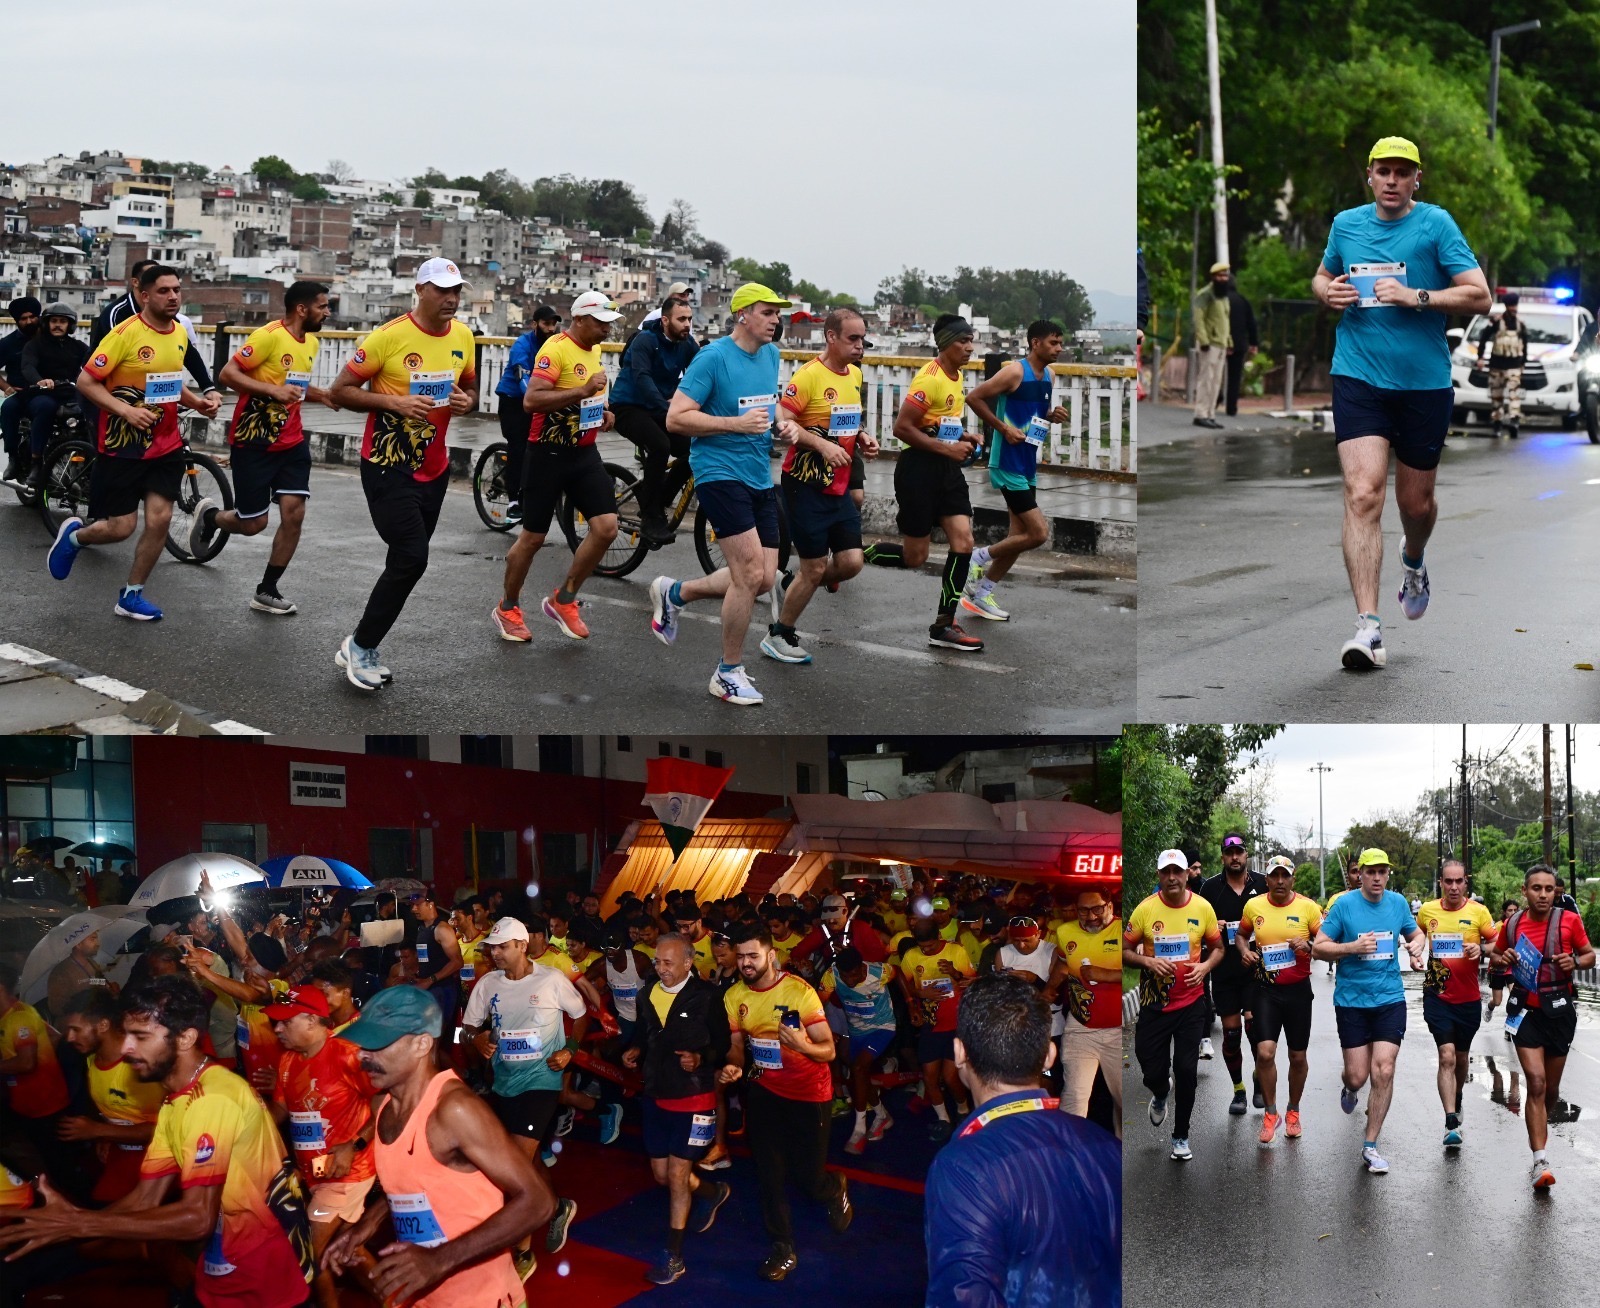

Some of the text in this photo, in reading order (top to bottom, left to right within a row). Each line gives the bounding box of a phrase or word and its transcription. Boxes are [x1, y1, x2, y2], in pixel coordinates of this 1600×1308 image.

[153, 382, 175, 393] 28015
[419, 384, 445, 396] 28019
[837, 415, 856, 425] 28012
[297, 786, 317, 797] SPORTS
[295, 870, 325, 879] ANI
[64, 922, 90, 944] IANS
[1161, 944, 1181, 952] 28019
[1269, 952, 1287, 961] 22211
